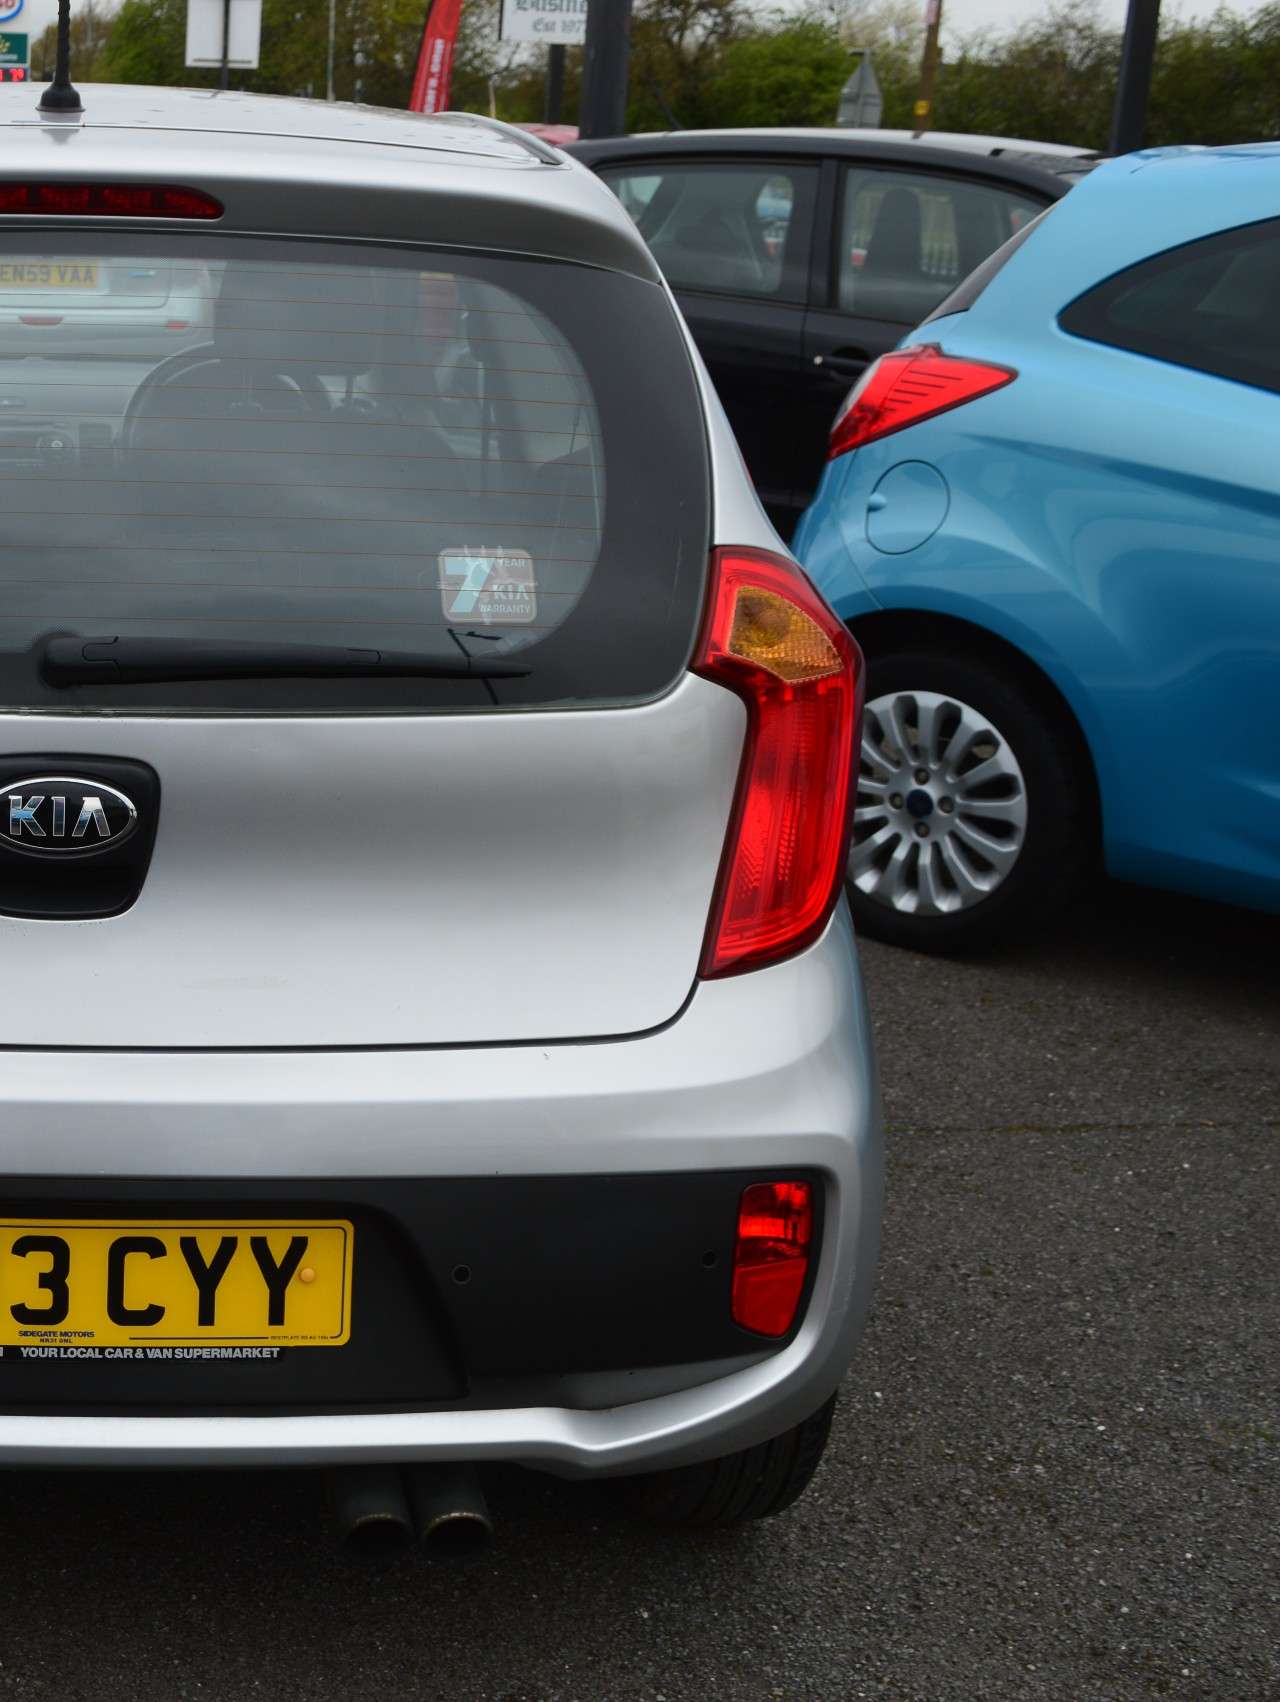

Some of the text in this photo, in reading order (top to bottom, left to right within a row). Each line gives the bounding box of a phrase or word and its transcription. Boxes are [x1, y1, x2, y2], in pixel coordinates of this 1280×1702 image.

[53, 264, 95, 284] VAA
[445, 556, 497, 613] 7
[492, 583, 530, 601] KIA
[479, 603, 531, 614] WARRANTY
[8, 794, 112, 838] KIA
[106, 1235, 309, 1327] CYY
[18, 1330, 59, 1338] SIDEGATE
[20, 1347, 281, 1359] YOUR LOCAL CAR & VAN SUPERMARKET
